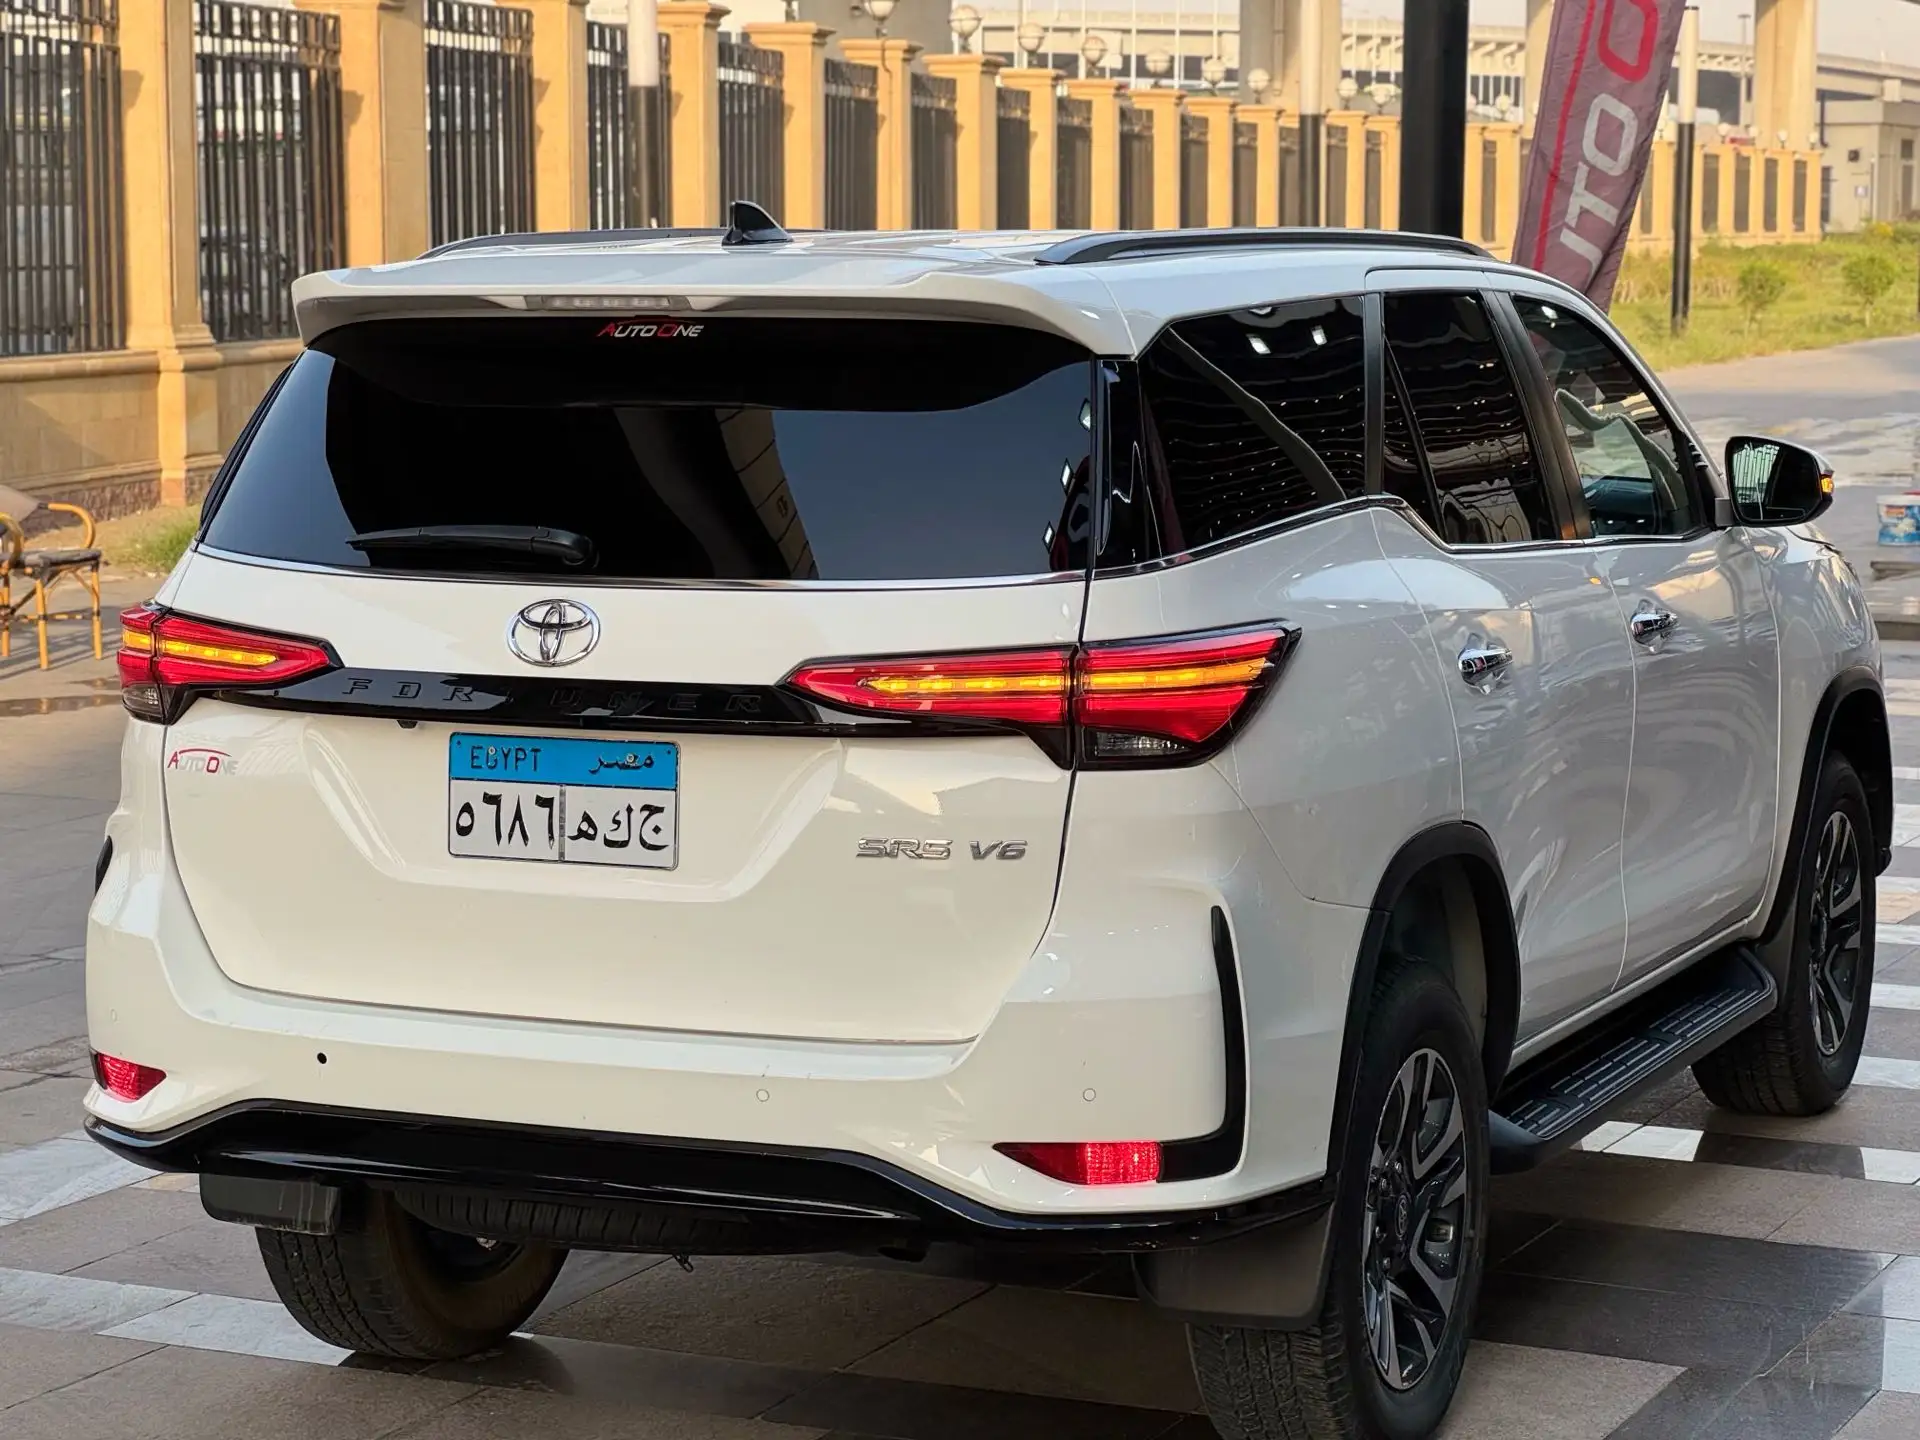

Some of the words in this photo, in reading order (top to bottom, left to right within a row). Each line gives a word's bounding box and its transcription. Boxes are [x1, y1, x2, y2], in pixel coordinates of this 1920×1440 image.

[657, 323, 704, 337] ONE
[341, 677, 762, 714] FORUNER
[469, 745, 542, 772] EGYPT
[588, 752, 655, 775] مصر
[455, 791, 556, 850] ٥٦٨٦
[969, 840, 1028, 860] V6
